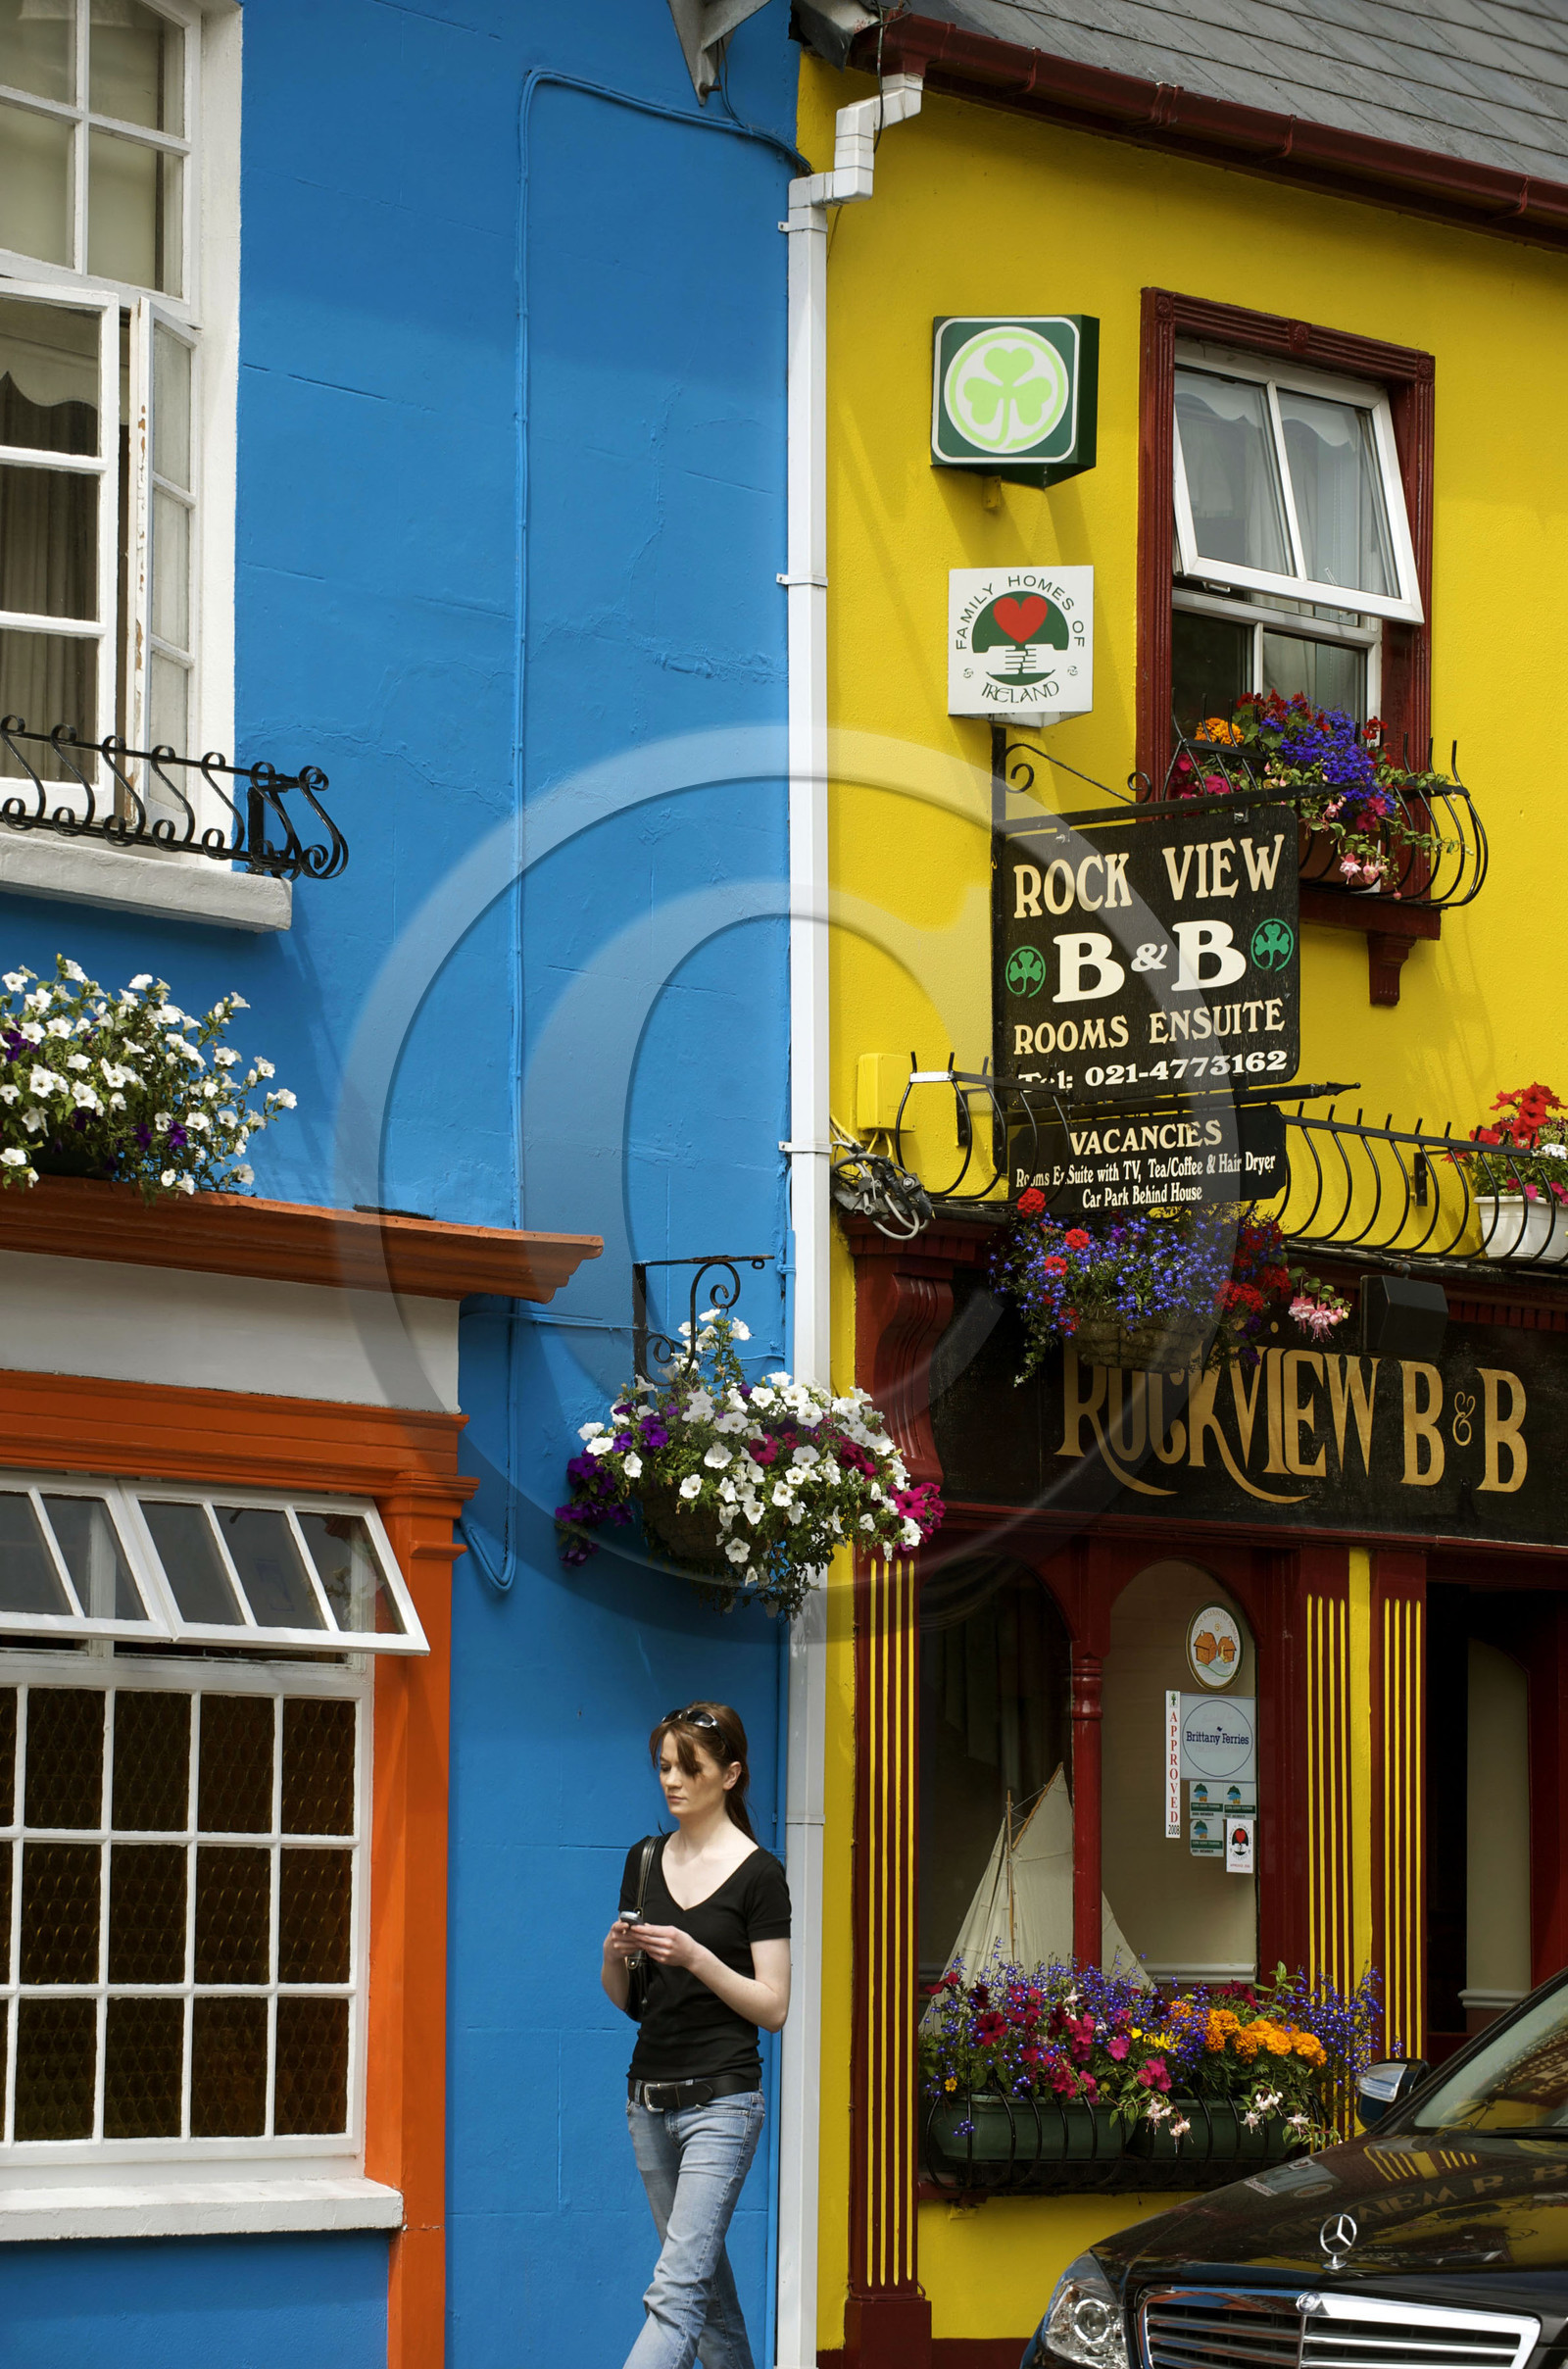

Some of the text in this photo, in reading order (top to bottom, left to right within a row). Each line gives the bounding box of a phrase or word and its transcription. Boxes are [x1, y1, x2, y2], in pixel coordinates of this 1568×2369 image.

[956, 574, 1085, 650] FAMILY HOMES OF
[981, 680, 1059, 704] IRELAND
[1013, 834, 1285, 918] ROCK VIEW
[1013, 998, 1286, 1056] ROOMS ENSUITE
[1085, 1050, 1288, 1087] 021-4773162
[1069, 1119, 1222, 1156] VACANCIES
[1097, 1162, 1119, 1183] with
[1123, 1160, 1141, 1182] TV,
[1148, 1156, 1203, 1178] Tea/Coffee
[1206, 1154, 1215, 1174] &
[1218, 1153, 1242, 1173] Hair
[1245, 1152, 1276, 1176] Dryer
[1083, 1182, 1202, 1209] Car Park Behind House
[1186, 1731, 1250, 1745] Brittany Ferries
[1170, 1711, 1179, 1823] APPROVED
[1168, 1824, 1180, 1836] 2008
